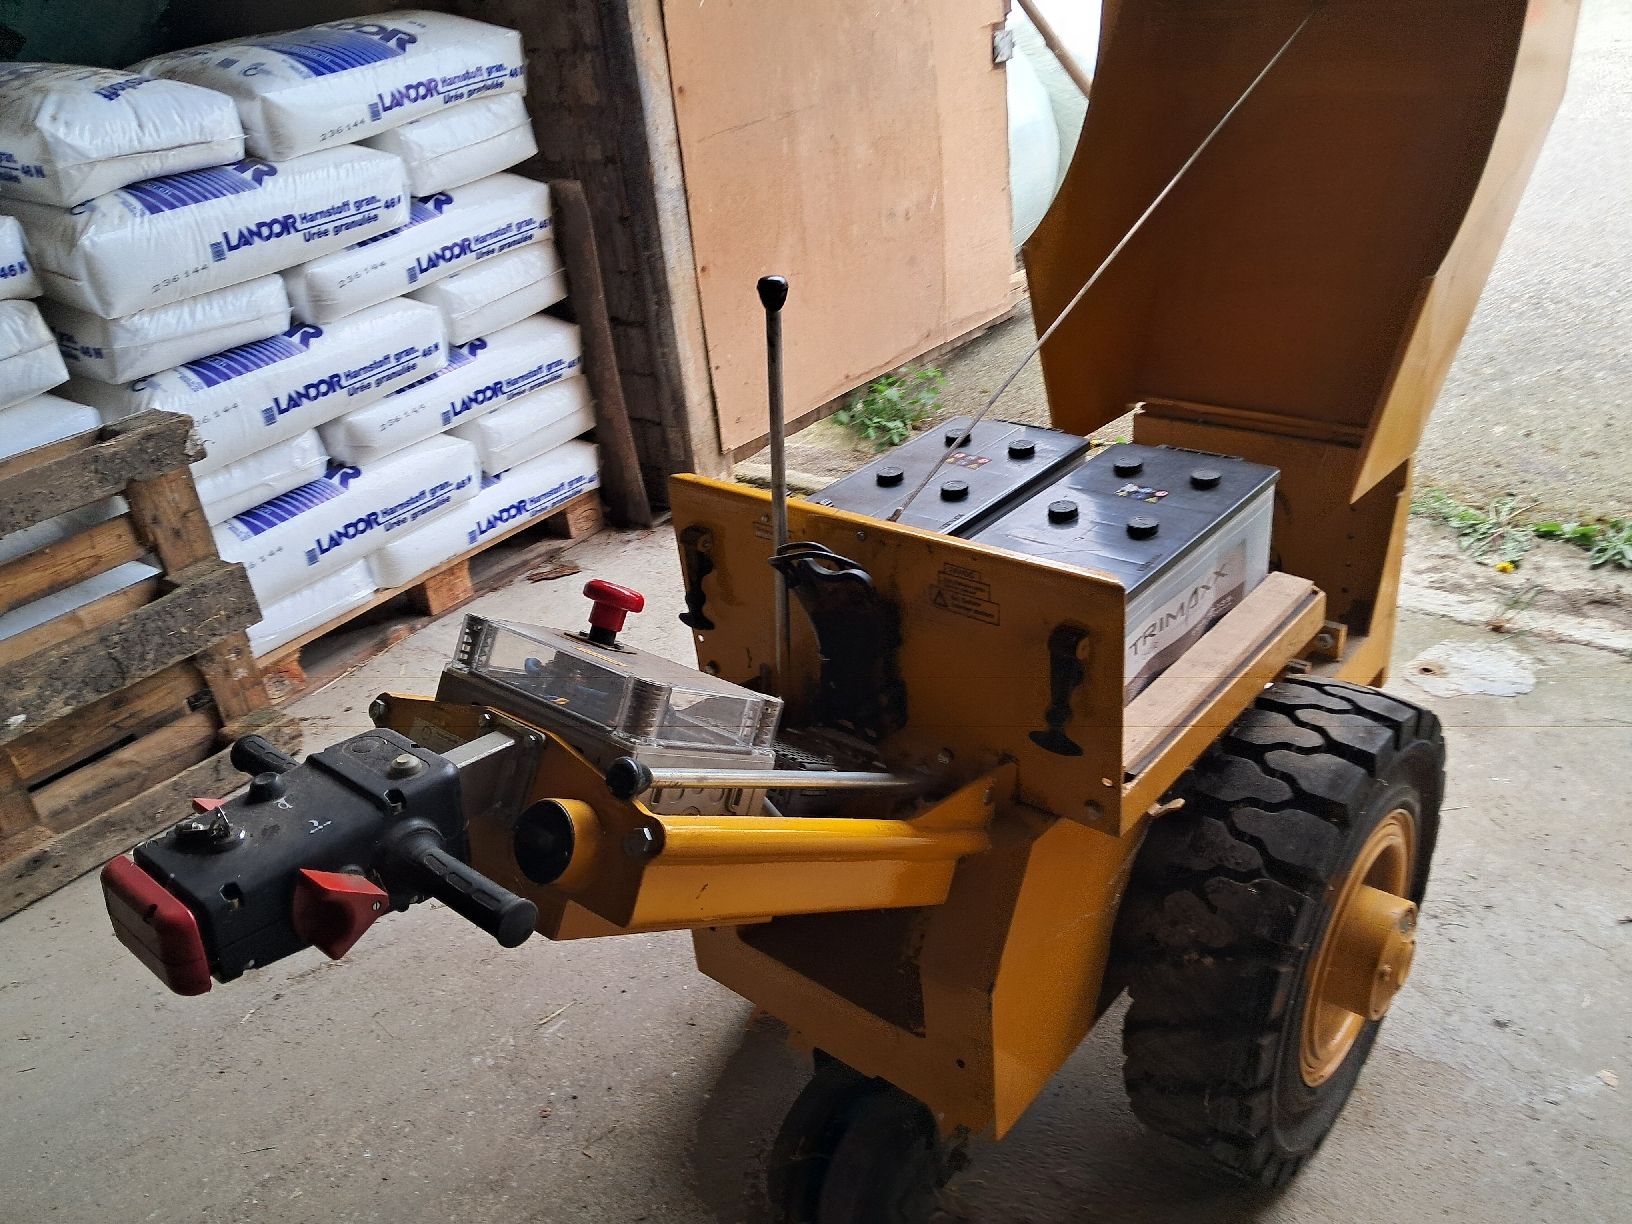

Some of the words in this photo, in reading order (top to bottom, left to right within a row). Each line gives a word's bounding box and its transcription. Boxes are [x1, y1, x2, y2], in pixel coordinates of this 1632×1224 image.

[377, 77, 440, 113] LANDOR
[440, 66, 483, 88] Harnstoff
[319, 117, 365, 143] 236144
[222, 213, 298, 252] LANDOR
[299, 200, 350, 224] Harnstoff
[354, 195, 381, 211] gran.
[303, 227, 329, 242] Urée
[333, 213, 379, 236] granulée
[416, 237, 473, 274] LANDOR
[151, 263, 208, 294] 236144
[273, 373, 343, 415] LANDOR
[343, 354, 391, 382] Harnstoff
[450, 380, 505, 417] LANDOR
[315, 511, 381, 556] LANDOR
[476, 499, 529, 536] LANDOR
[1128, 563, 1229, 656] TRIMAX
